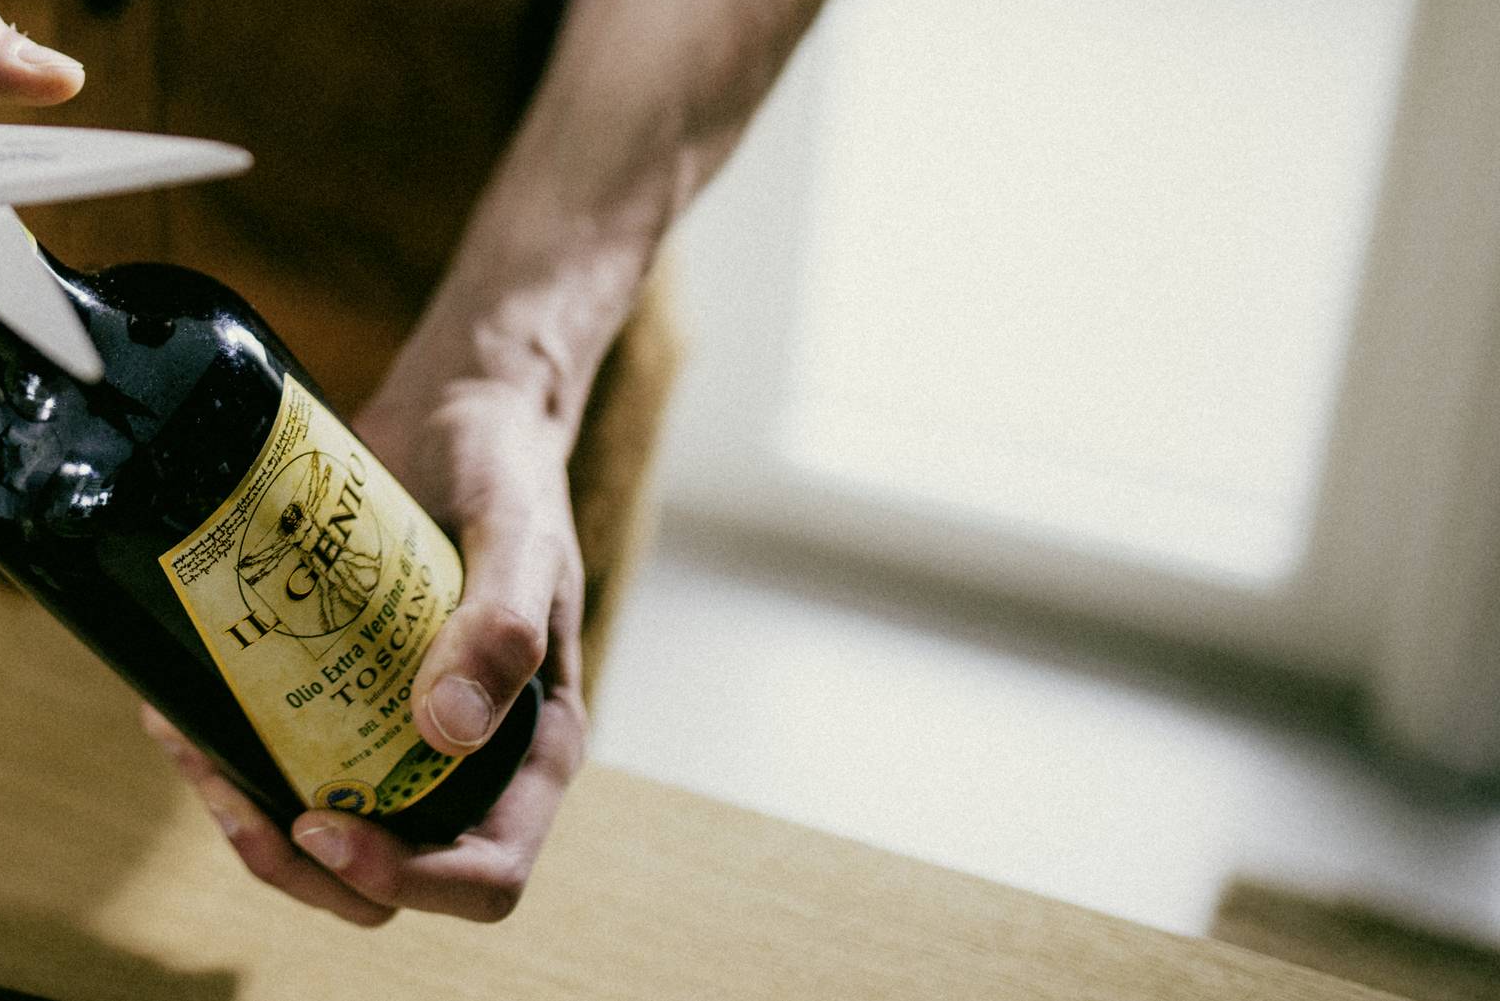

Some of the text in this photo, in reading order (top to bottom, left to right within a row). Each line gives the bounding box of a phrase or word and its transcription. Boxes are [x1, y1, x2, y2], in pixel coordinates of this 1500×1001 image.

[225, 610, 283, 651] IL
[286, 453, 368, 601] GENIO
[285, 681, 324, 709] Olio
[321, 643, 366, 685] Extra
[360, 578, 407, 643] Vergine
[330, 564, 431, 707] TOSCANO
